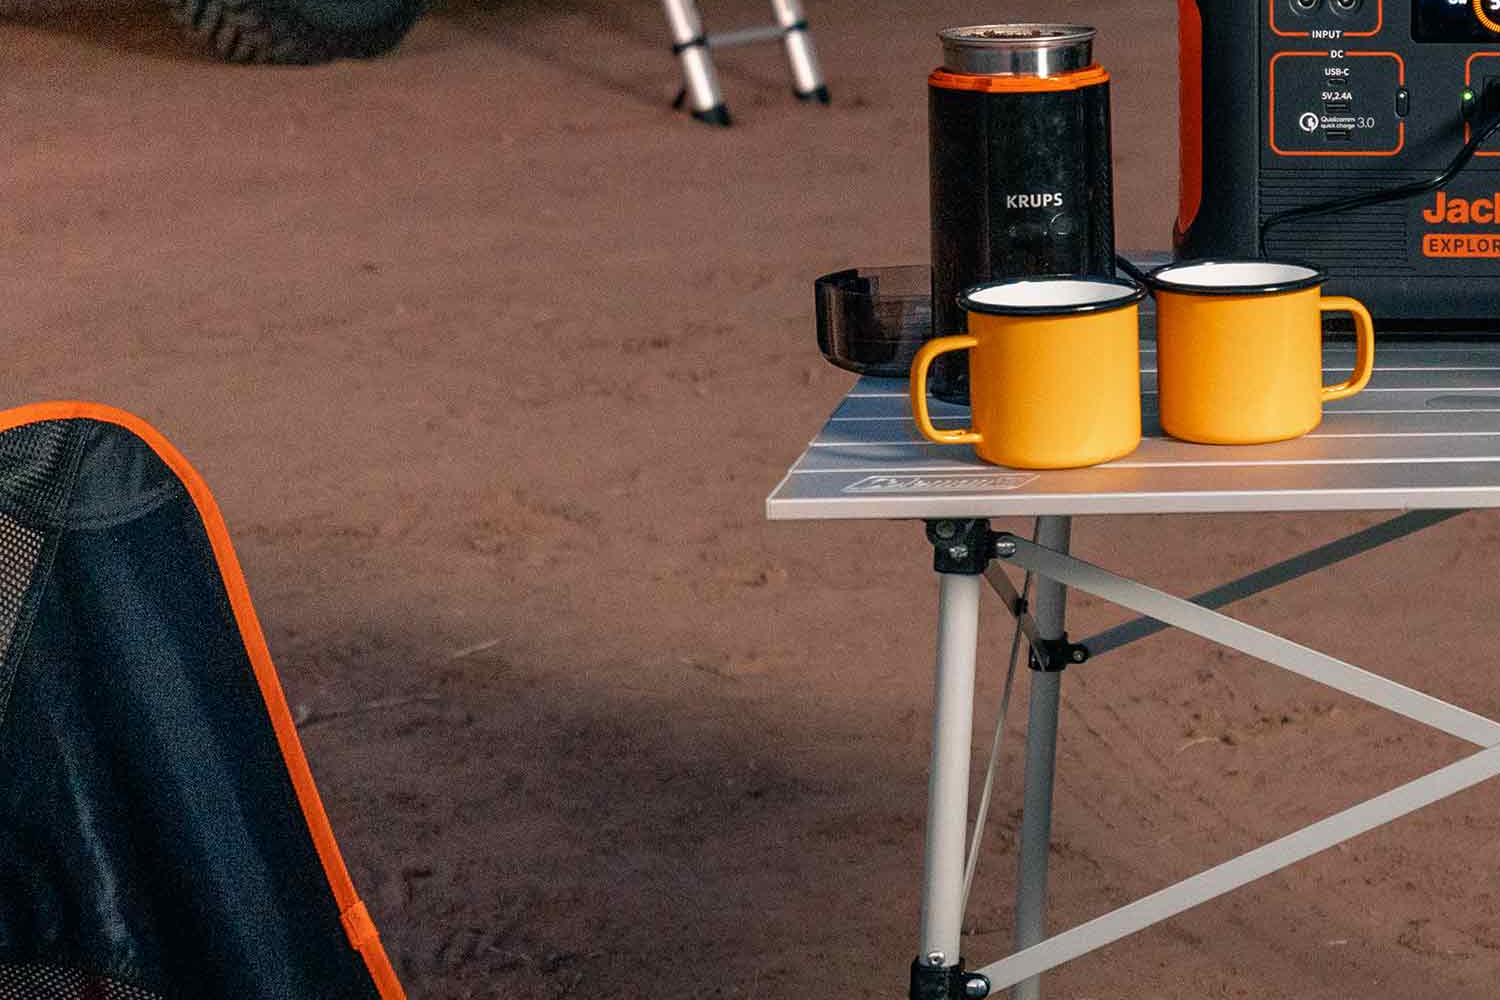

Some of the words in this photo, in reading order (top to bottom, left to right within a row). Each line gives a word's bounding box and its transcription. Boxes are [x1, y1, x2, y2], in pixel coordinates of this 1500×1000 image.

[1311, 29, 1342, 39] INPUT
[1330, 49, 1344, 59] DC
[1324, 67, 1351, 76] USB-C
[1356, 116, 1375, 129] 3.0
[1007, 192, 1063, 209] KRUPS
